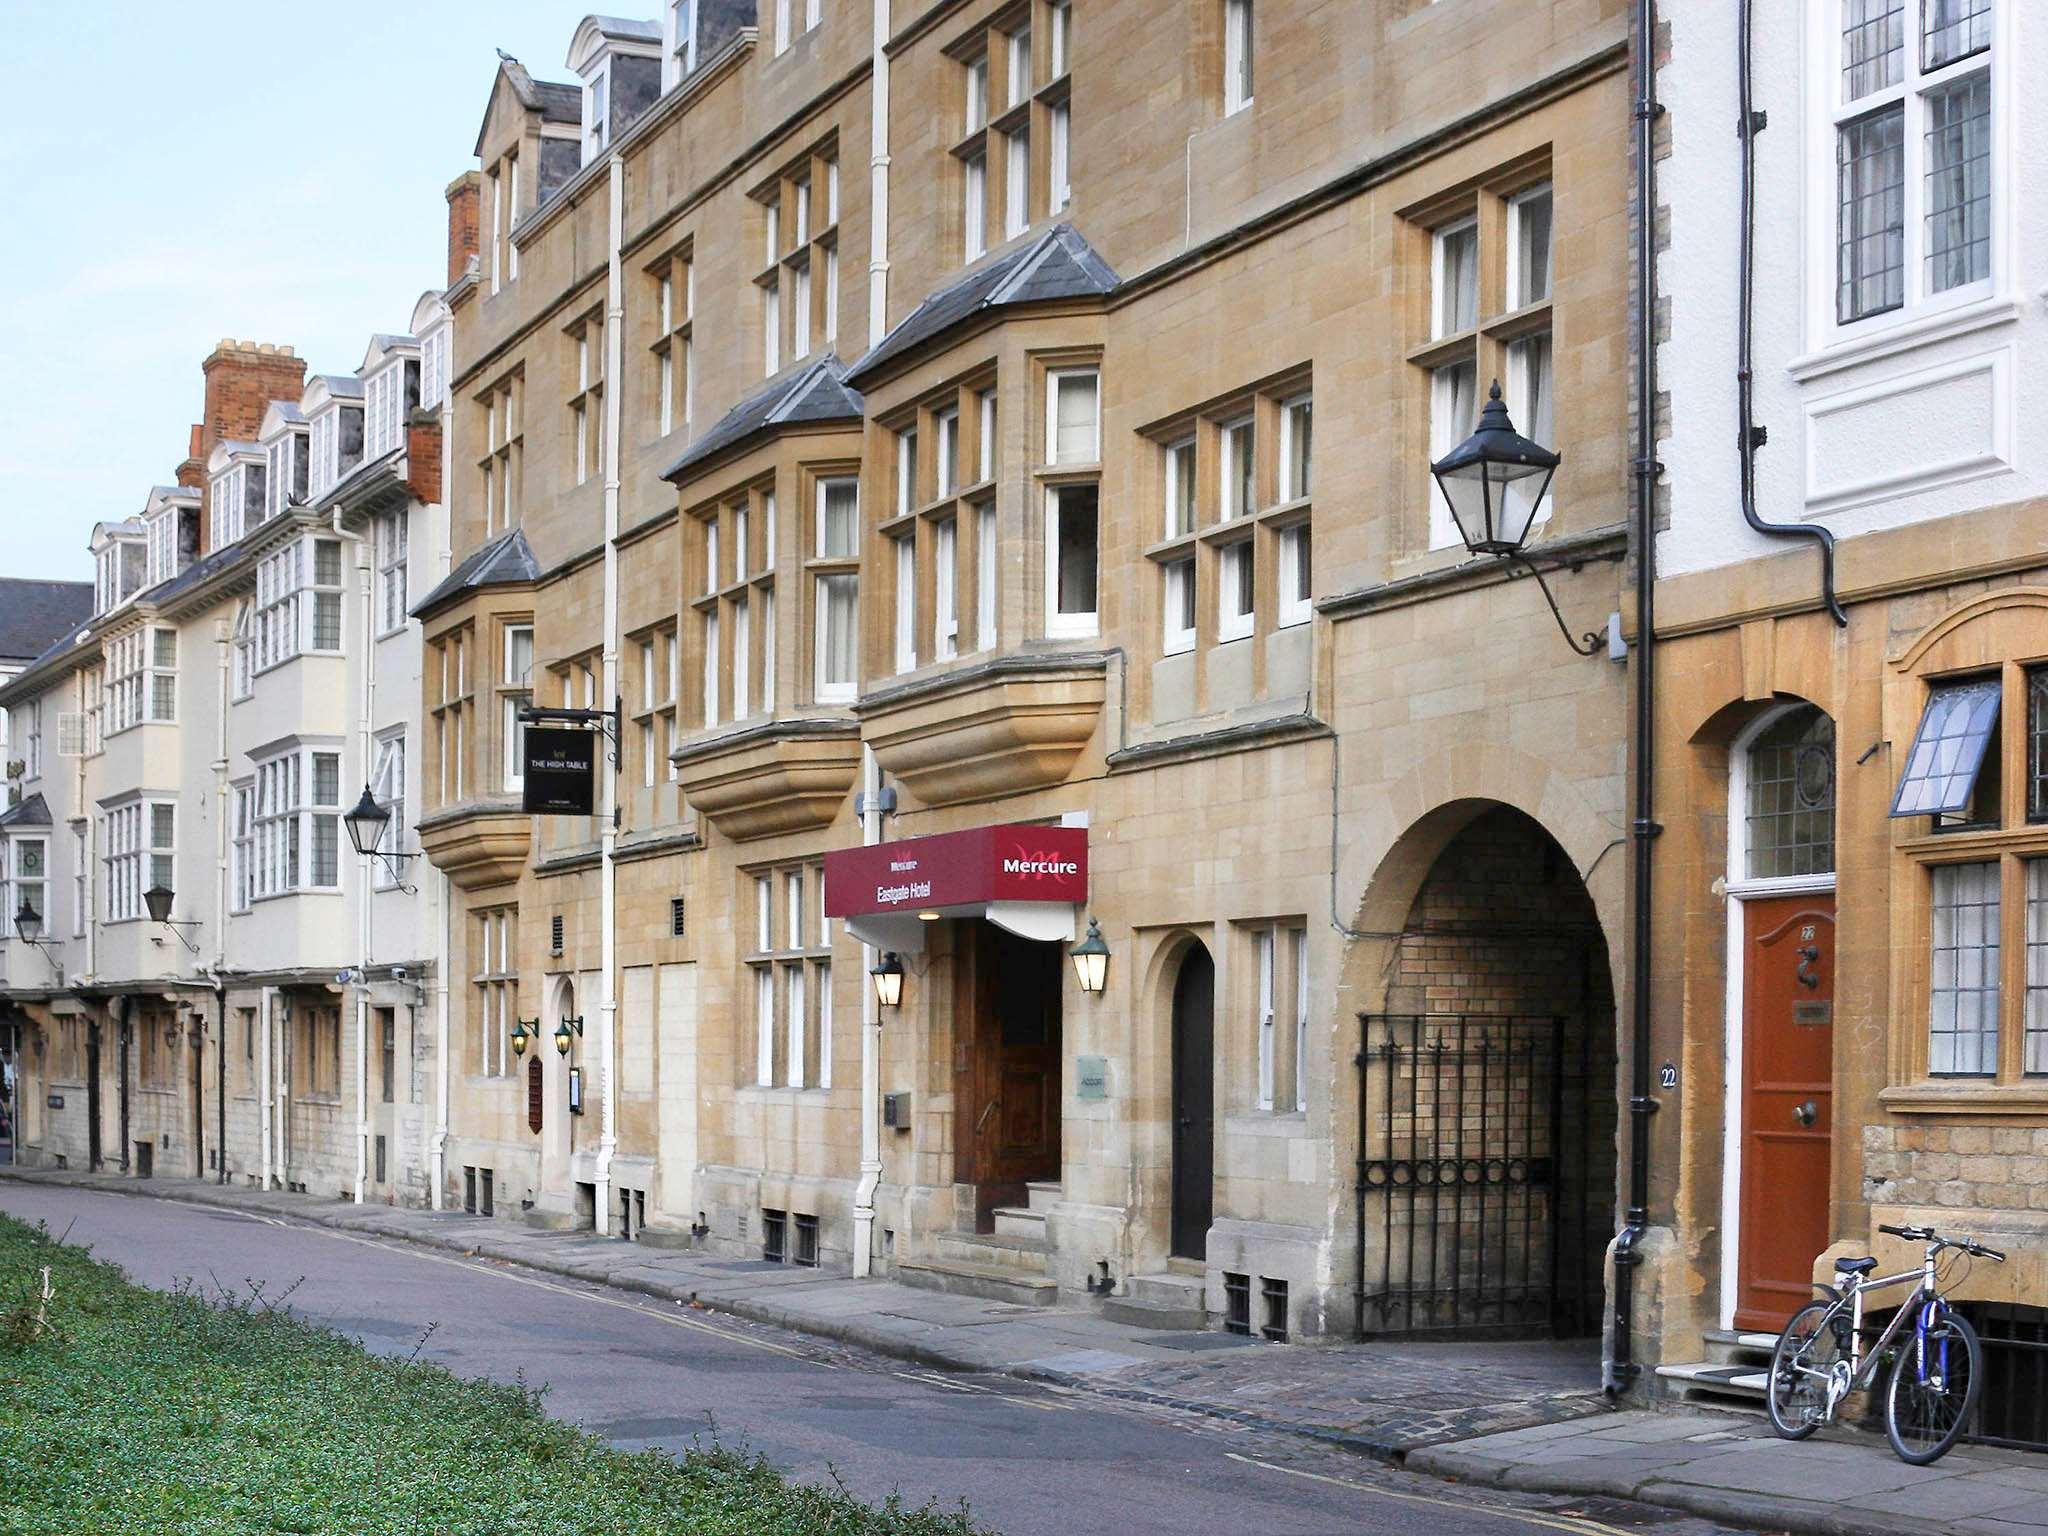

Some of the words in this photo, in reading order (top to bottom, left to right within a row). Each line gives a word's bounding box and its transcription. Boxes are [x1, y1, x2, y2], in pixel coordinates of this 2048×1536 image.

[531, 760, 545, 768] THE
[546, 761, 565, 769] HIGH
[566, 761, 588, 770] TABLE
[890, 861, 918, 872] Mercure
[1003, 859, 1077, 874] Mercure
[877, 885, 910, 905] Eastgate
[910, 881, 931, 898] Hotel
[1802, 925, 1816, 940] 22
[1661, 1068, 1676, 1087] 22
